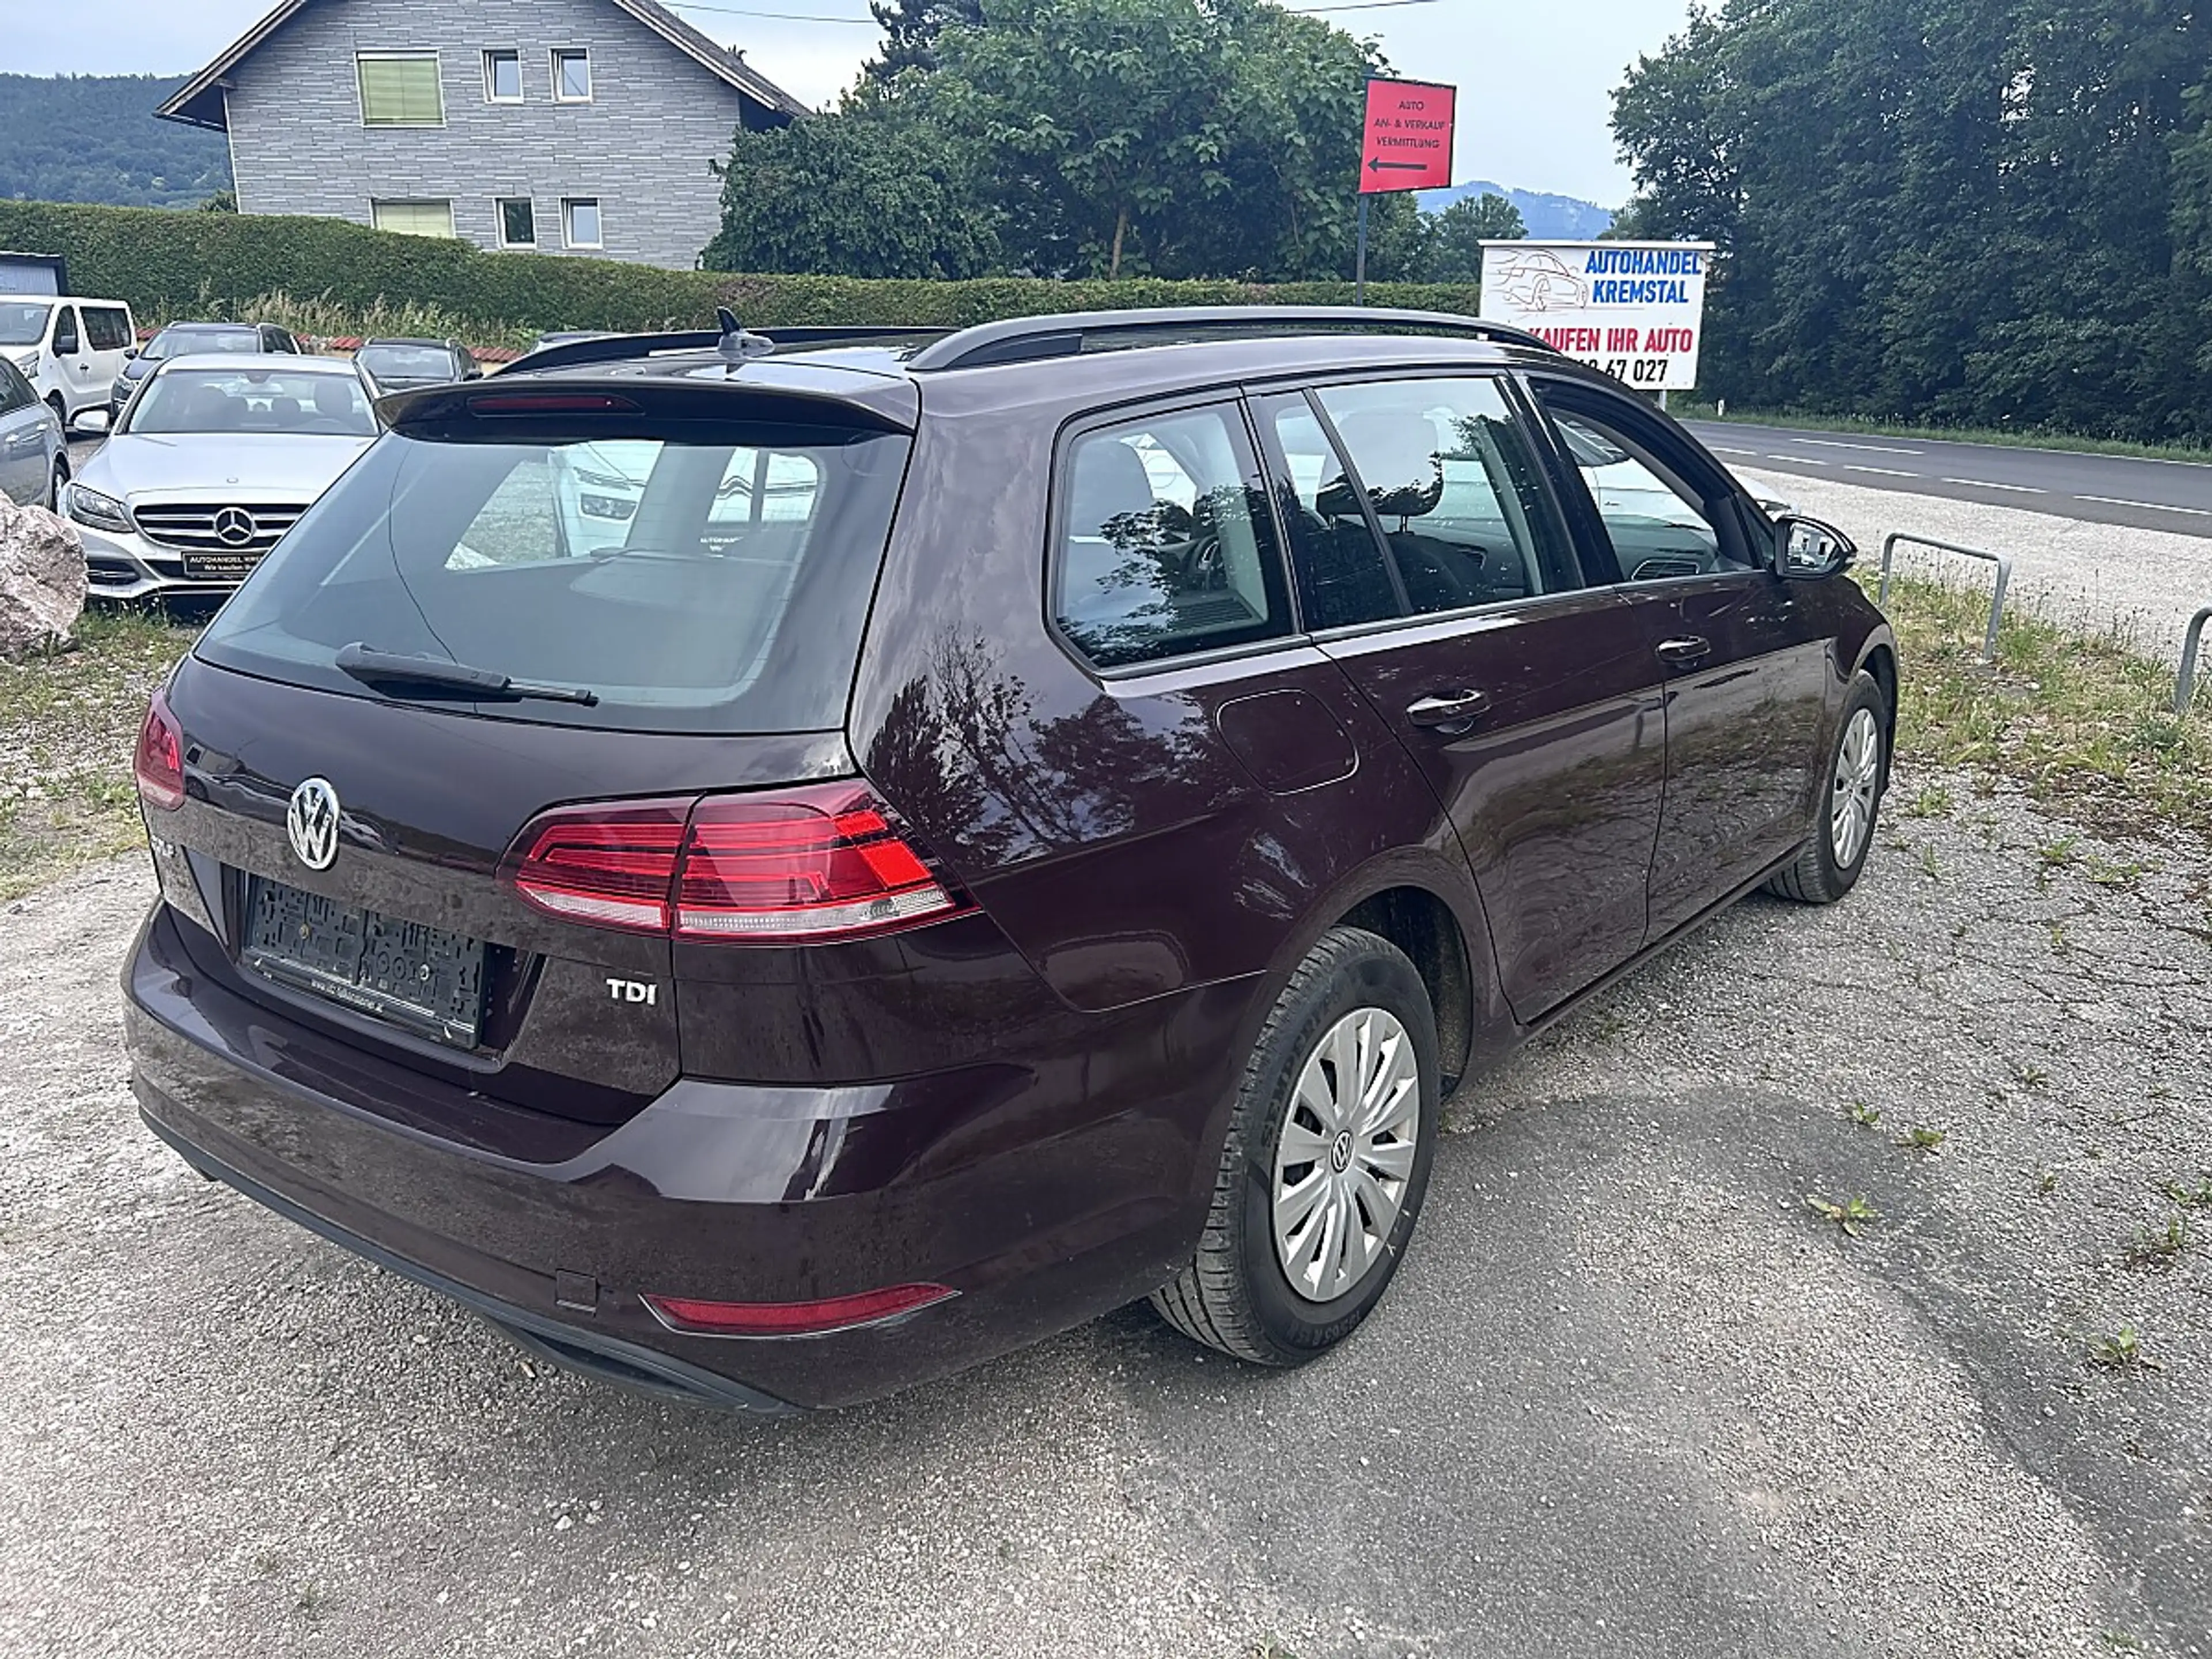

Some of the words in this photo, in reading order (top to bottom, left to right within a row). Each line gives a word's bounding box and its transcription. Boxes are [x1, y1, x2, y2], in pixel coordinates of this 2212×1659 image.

[1398, 101, 1424, 111] AUTO
[1374, 118, 1391, 127] AN-
[1395, 119, 1401, 128] &
[1404, 119, 1445, 130] VERKAUF
[1376, 137, 1440, 148] VERMITTLUNG
[1585, 251, 1702, 274] AUTOHANDEL
[1592, 281, 1689, 303] KREMSTAL
[1607, 328, 1639, 353] IHR
[1643, 328, 1693, 353] AUTO
[1633, 359, 1668, 382] 027
[606, 979, 657, 1005] TDI
